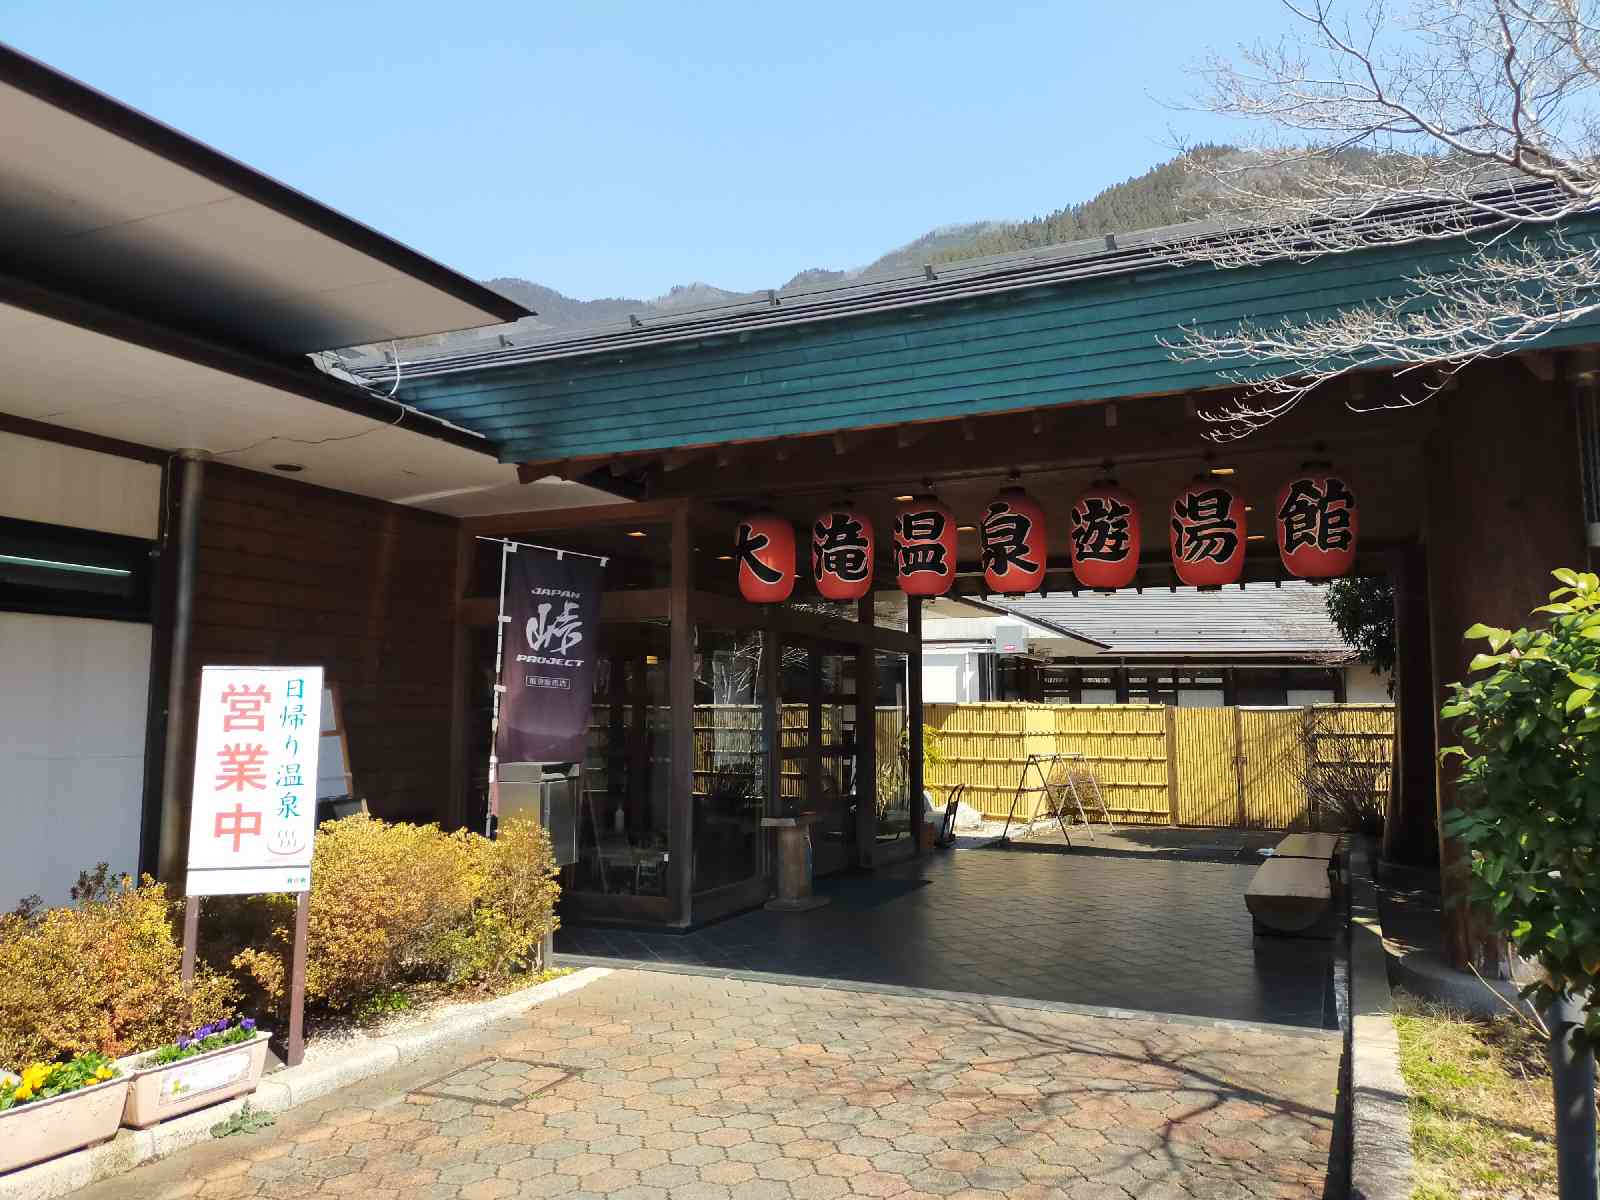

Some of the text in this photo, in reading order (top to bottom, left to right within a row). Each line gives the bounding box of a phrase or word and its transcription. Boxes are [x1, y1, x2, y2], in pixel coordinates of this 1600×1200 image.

[531, 587, 581, 599] JAPAN
[526, 600, 583, 655] 峠
[515, 654, 585, 667] PROJECT
[214, 683, 272, 852] 営業中
[275, 678, 307, 819] 日帰り温泉
